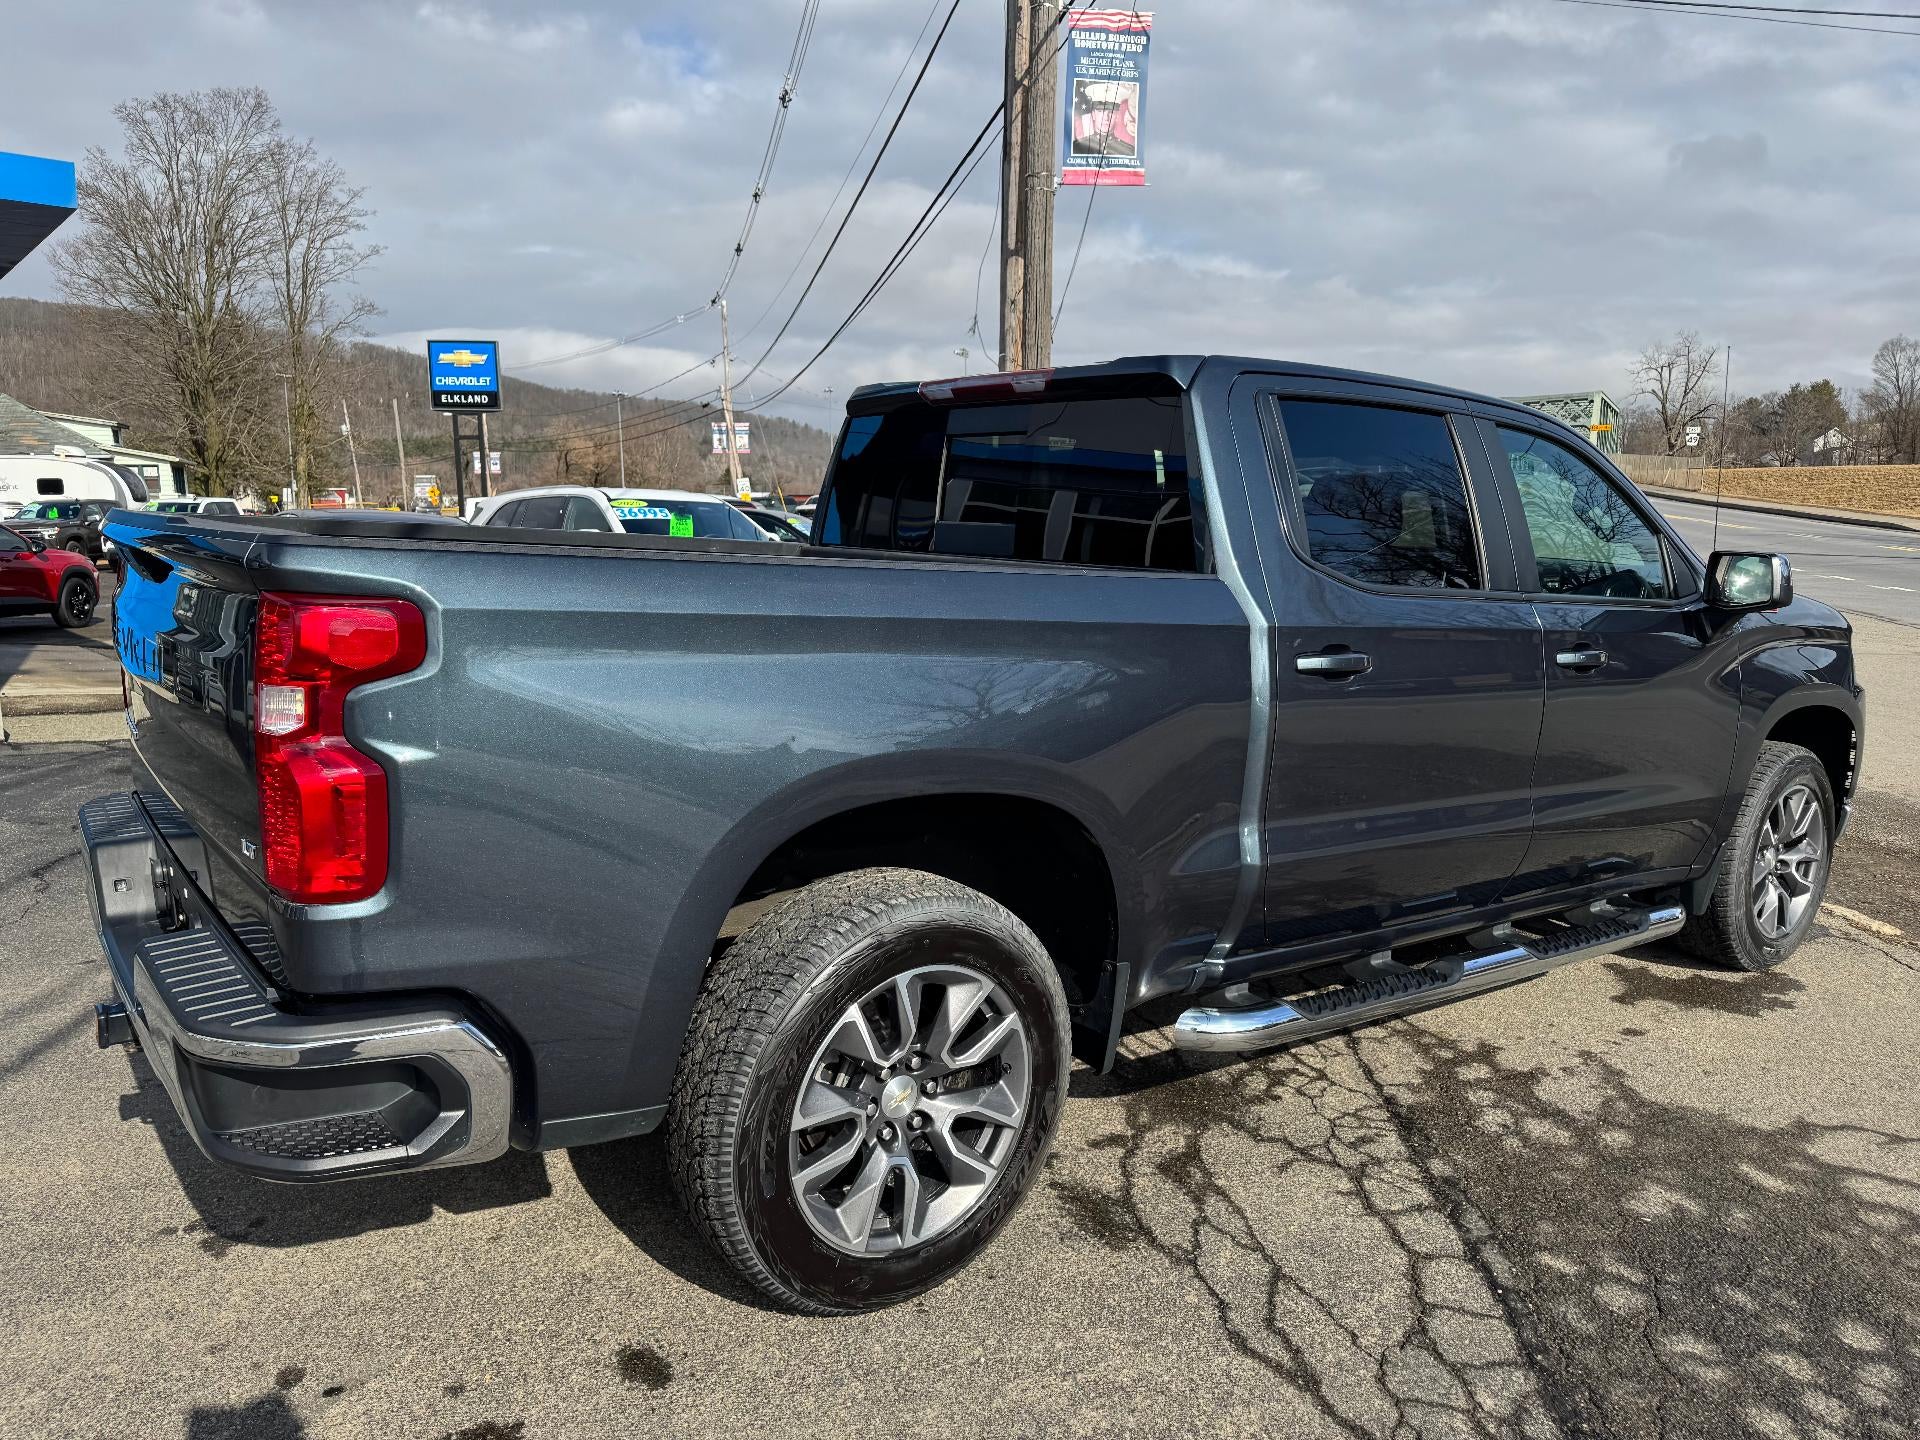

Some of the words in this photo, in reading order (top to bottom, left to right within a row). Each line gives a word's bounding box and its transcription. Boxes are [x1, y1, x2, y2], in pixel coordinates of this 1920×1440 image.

[1071, 31, 1106, 41] ELKLAND
[1108, 33, 1147, 45] BOROUGH
[1074, 39, 1119, 51] HOMETOWN
[1121, 43, 1143, 53] HERO
[1080, 57, 1112, 66] MICHAEL
[1088, 68, 1117, 76] MARINE
[1117, 69, 1139, 78] CORPS
[435, 376, 492, 386] CHEVROLET
[441, 395, 489, 404] ELKLAND
[1687, 436, 1698, 444] 49
[615, 508, 669, 518] 36995
[240, 838, 257, 860] LT
